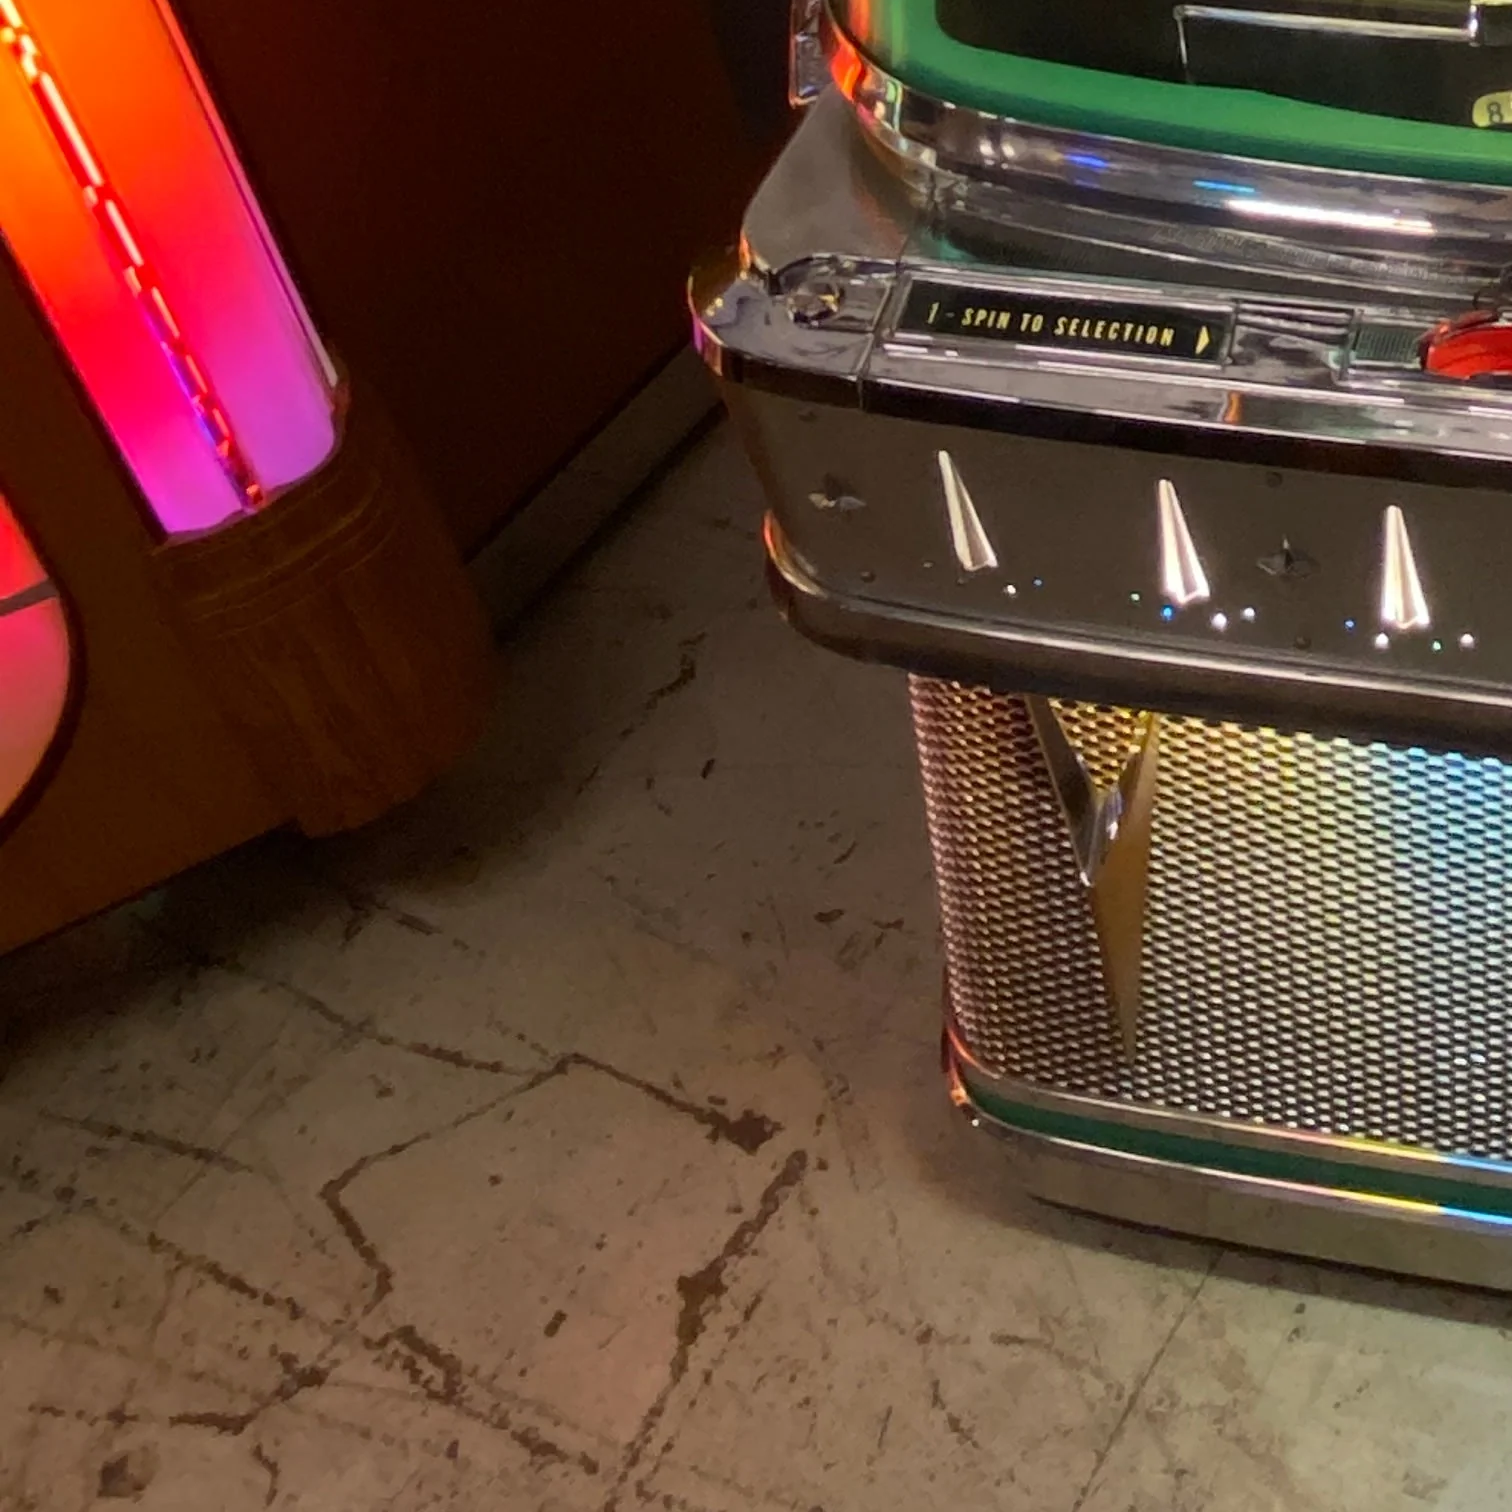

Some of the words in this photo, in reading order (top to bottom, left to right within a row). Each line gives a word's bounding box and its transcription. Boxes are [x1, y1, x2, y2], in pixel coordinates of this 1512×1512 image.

[1486, 101, 1504, 124] 8
[926, 302, 942, 326] 1
[961, 306, 1012, 331] SPIN
[1019, 312, 1045, 333] TO
[1054, 316, 1176, 348] SELECTION
